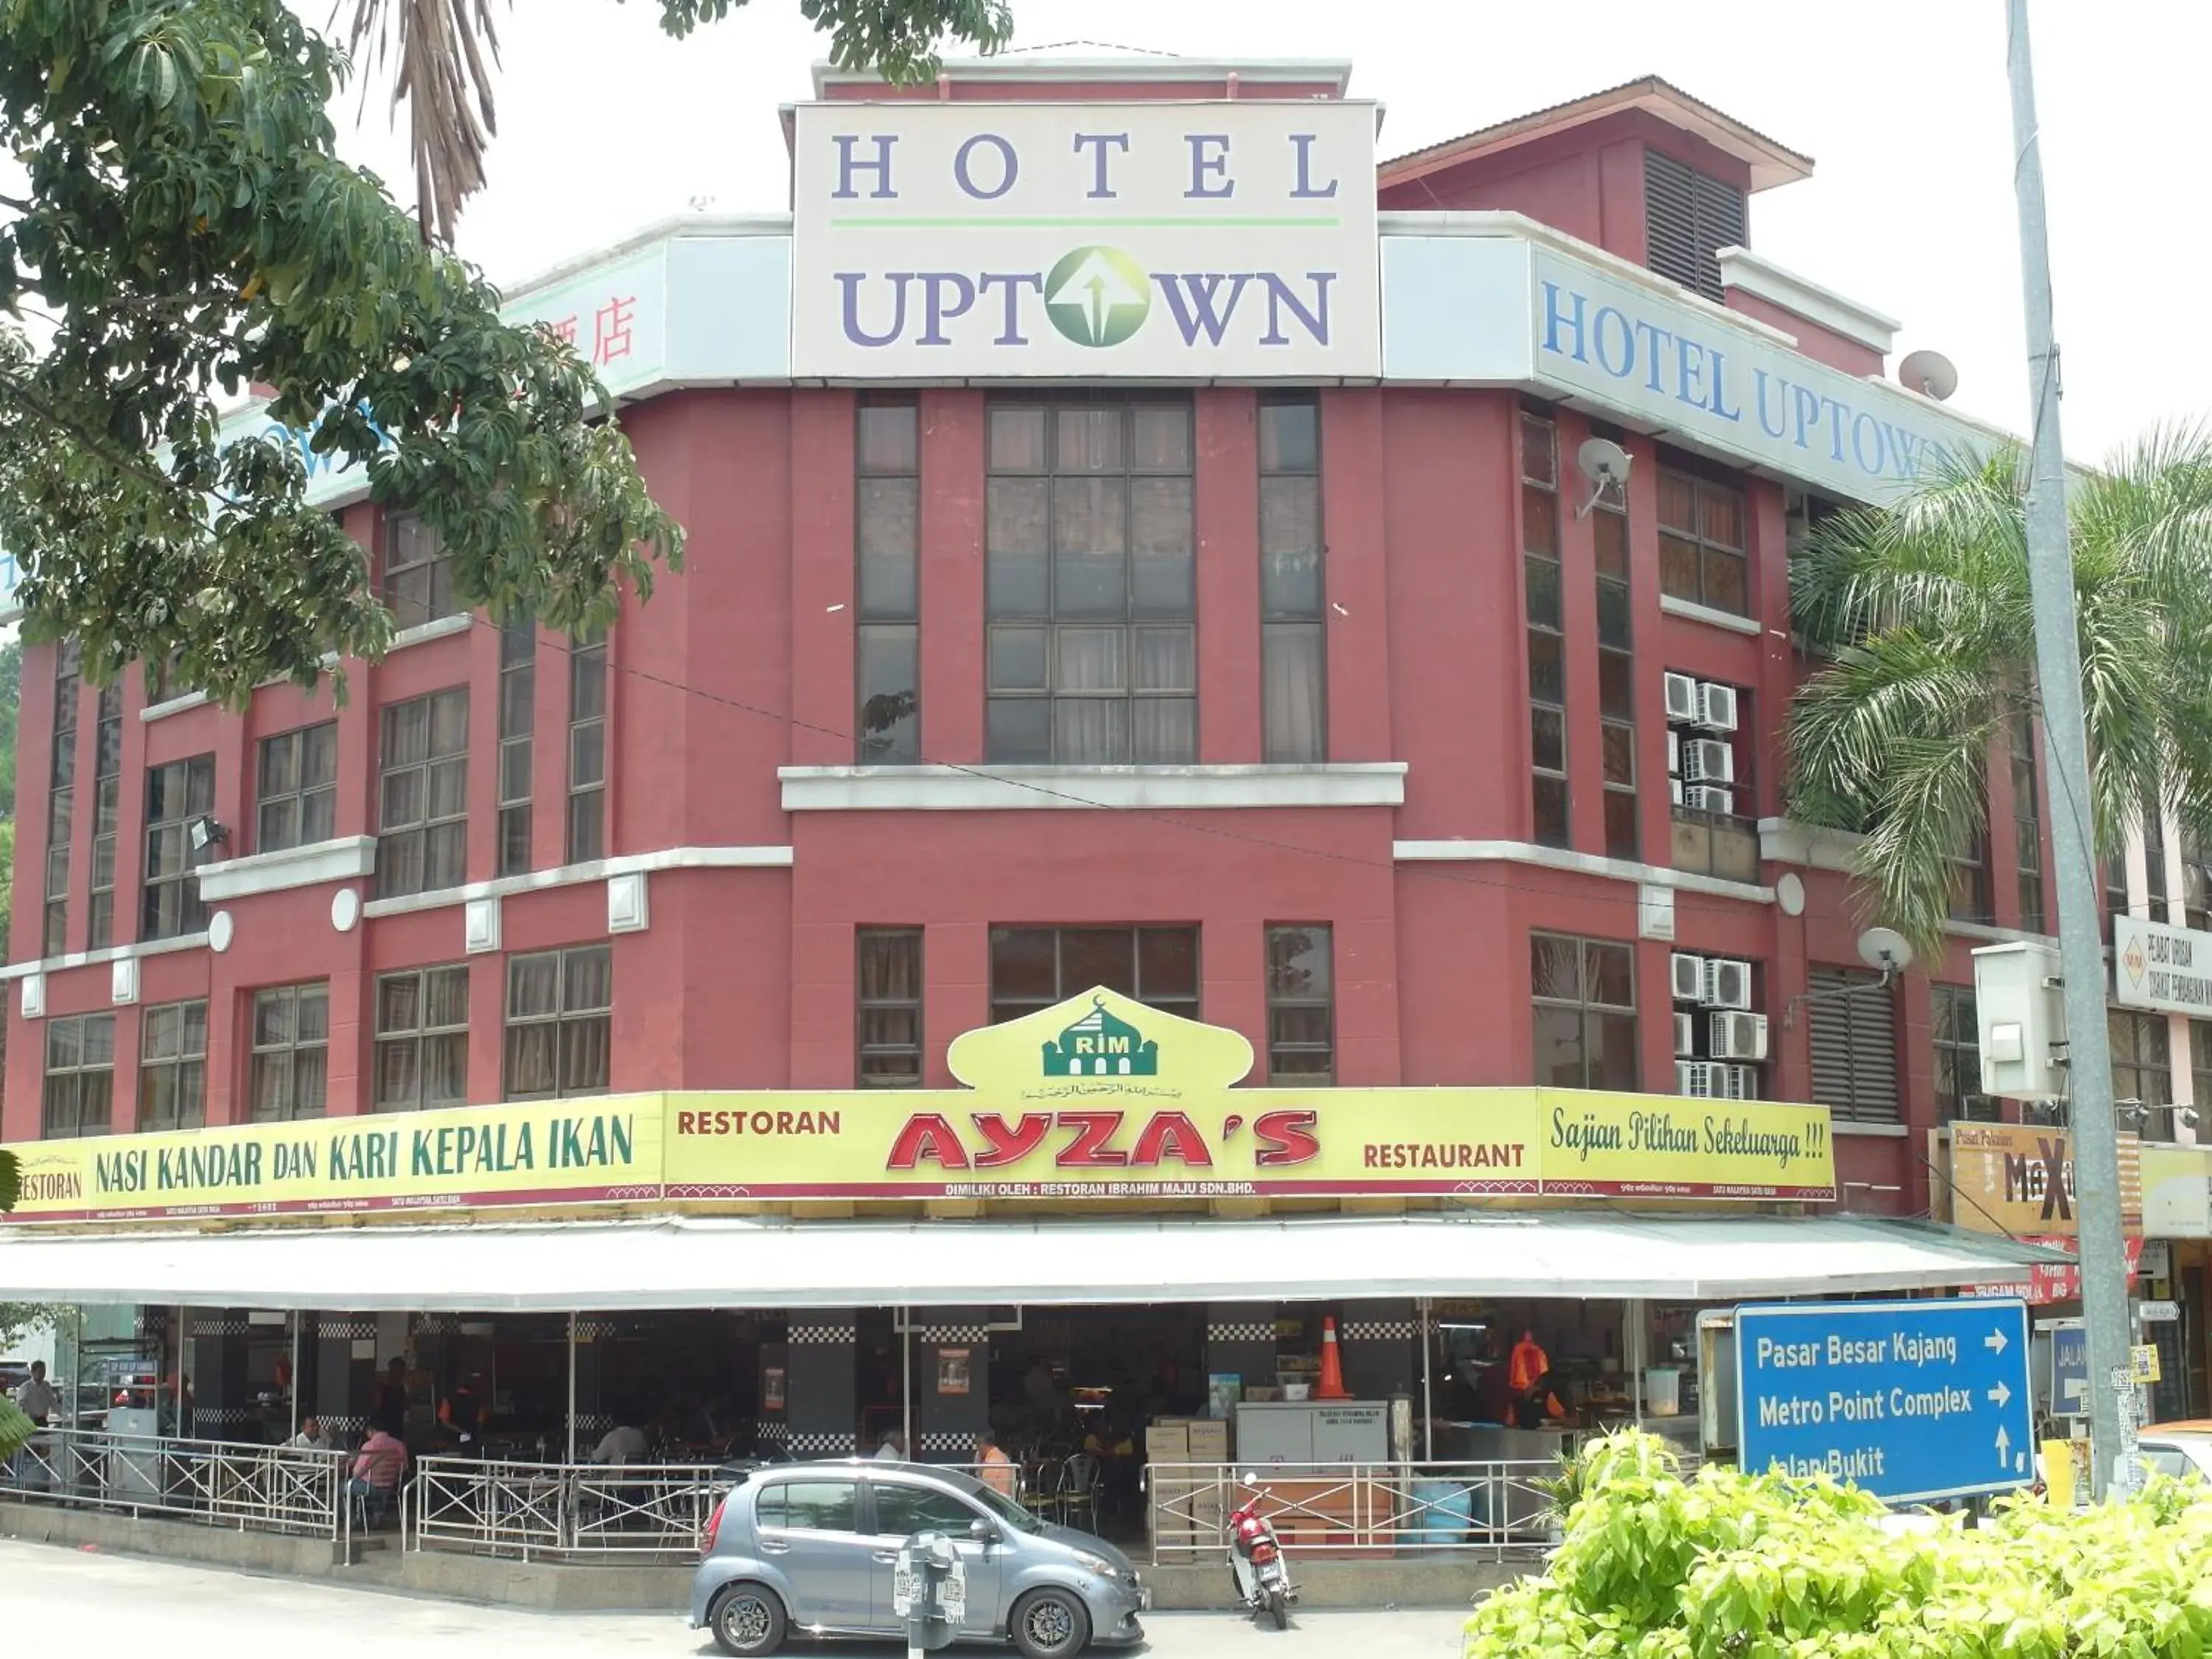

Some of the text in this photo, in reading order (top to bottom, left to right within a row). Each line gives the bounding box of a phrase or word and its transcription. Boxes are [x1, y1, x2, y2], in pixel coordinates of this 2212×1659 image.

[831, 133, 1338, 200] HOTEL
[1541, 280, 1741, 422] HOTEL
[96, 1113, 633, 1193] NASI KANDAR DAN KARI KEPALA IKAN
[678, 1110, 1525, 1168] RESTORAN AYZA'S RESTAURANT
[1550, 1107, 1622, 1162] Sajian
[1628, 1111, 1699, 1153] Pilihan
[1703, 1116, 1801, 1169] Sekeluarga
[945, 1183, 996, 1196] DIMILIKI
[998, 1183, 1031, 1195] OLEH
[1040, 1183, 1105, 1195] RESTORAN
[1108, 1183, 1160, 1195] IBRAHIM
[1162, 1183, 1197, 1195] MAJU
[1757, 1332, 1957, 1369] Pasar Besar Kajang
[1759, 1385, 1972, 1427] Metro Point Complex
[1770, 1446, 1885, 1479] alan Bukit
